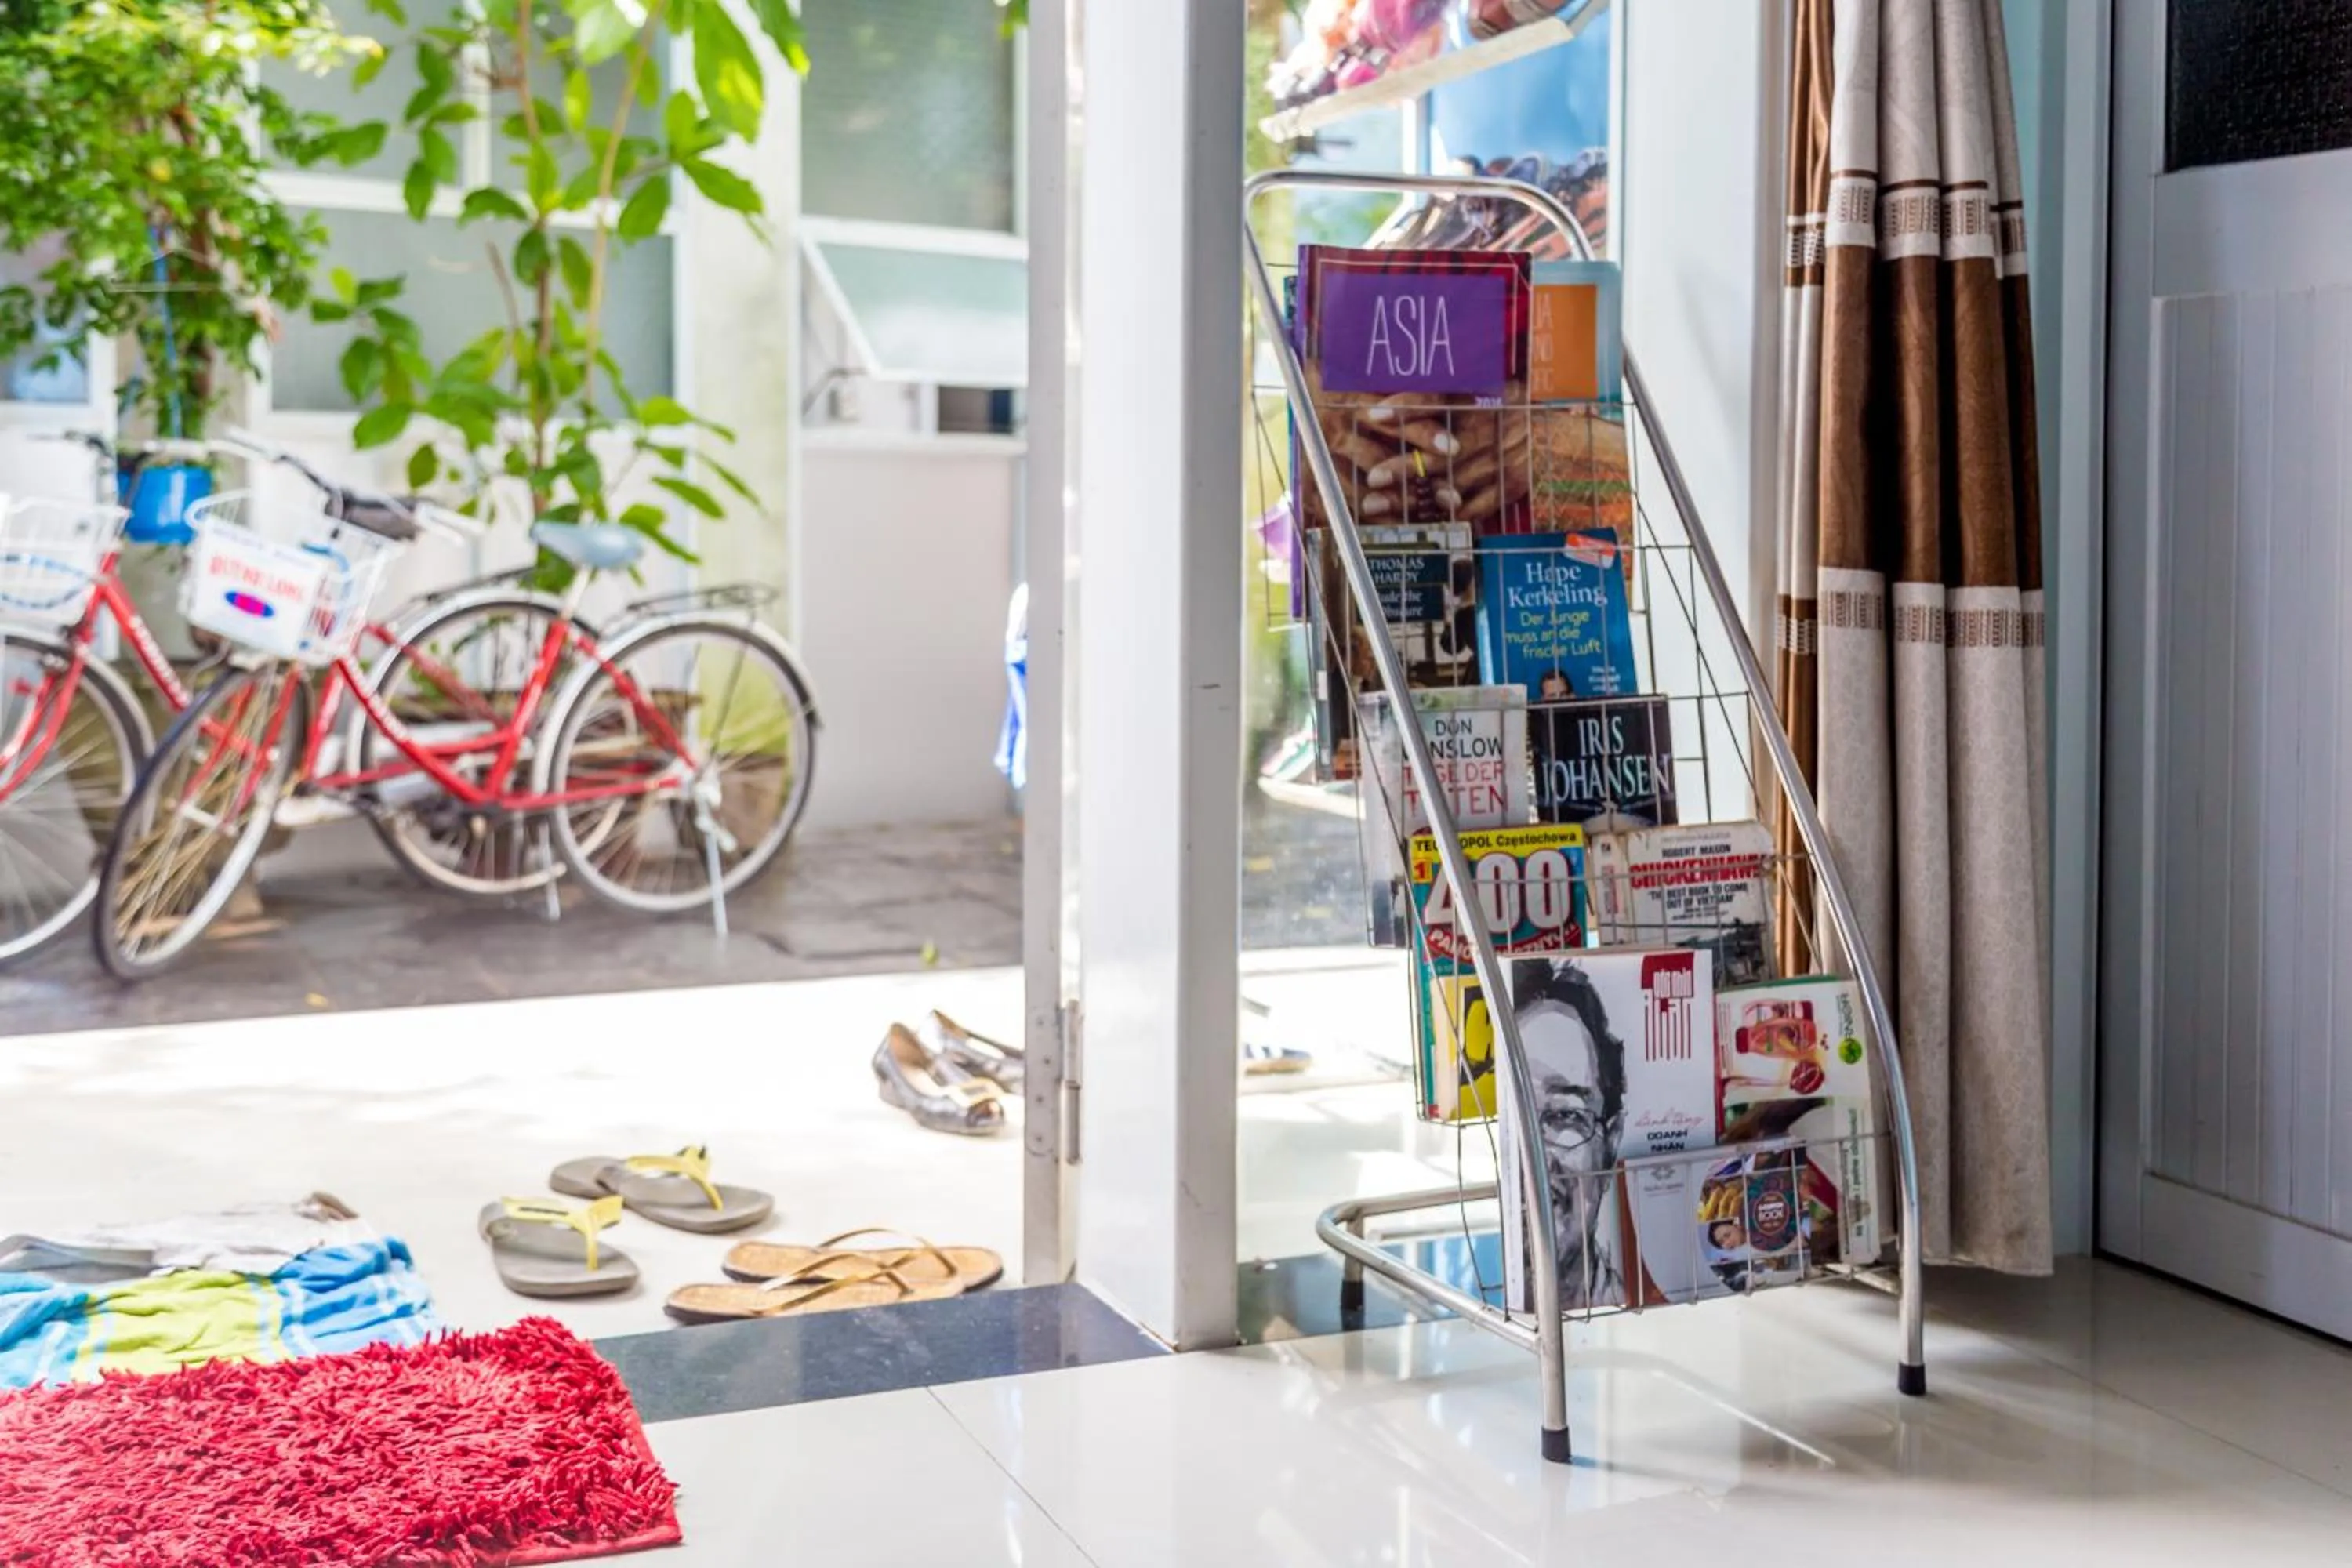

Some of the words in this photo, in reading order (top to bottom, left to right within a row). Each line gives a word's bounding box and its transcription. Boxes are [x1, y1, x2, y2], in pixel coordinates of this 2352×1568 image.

[1366, 296, 1455, 376] ASIA
[1526, 562, 1581, 586] Hape
[1508, 584, 1608, 608] Kerkeling
[1520, 612, 1545, 626] Der
[1548, 611, 1589, 628] Junge
[1505, 630, 1538, 644] muss
[1559, 625, 1580, 640] die
[1572, 638, 1602, 655] Luft
[1435, 717, 1472, 736] DON
[1403, 738, 1503, 759] NSLOW
[1403, 762, 1460, 784] TGE
[1466, 761, 1505, 782] DER
[1542, 753, 1671, 806] JOHANSEN
[1403, 785, 1508, 815] TTEN
[1496, 832, 1577, 848] Częstochowa
